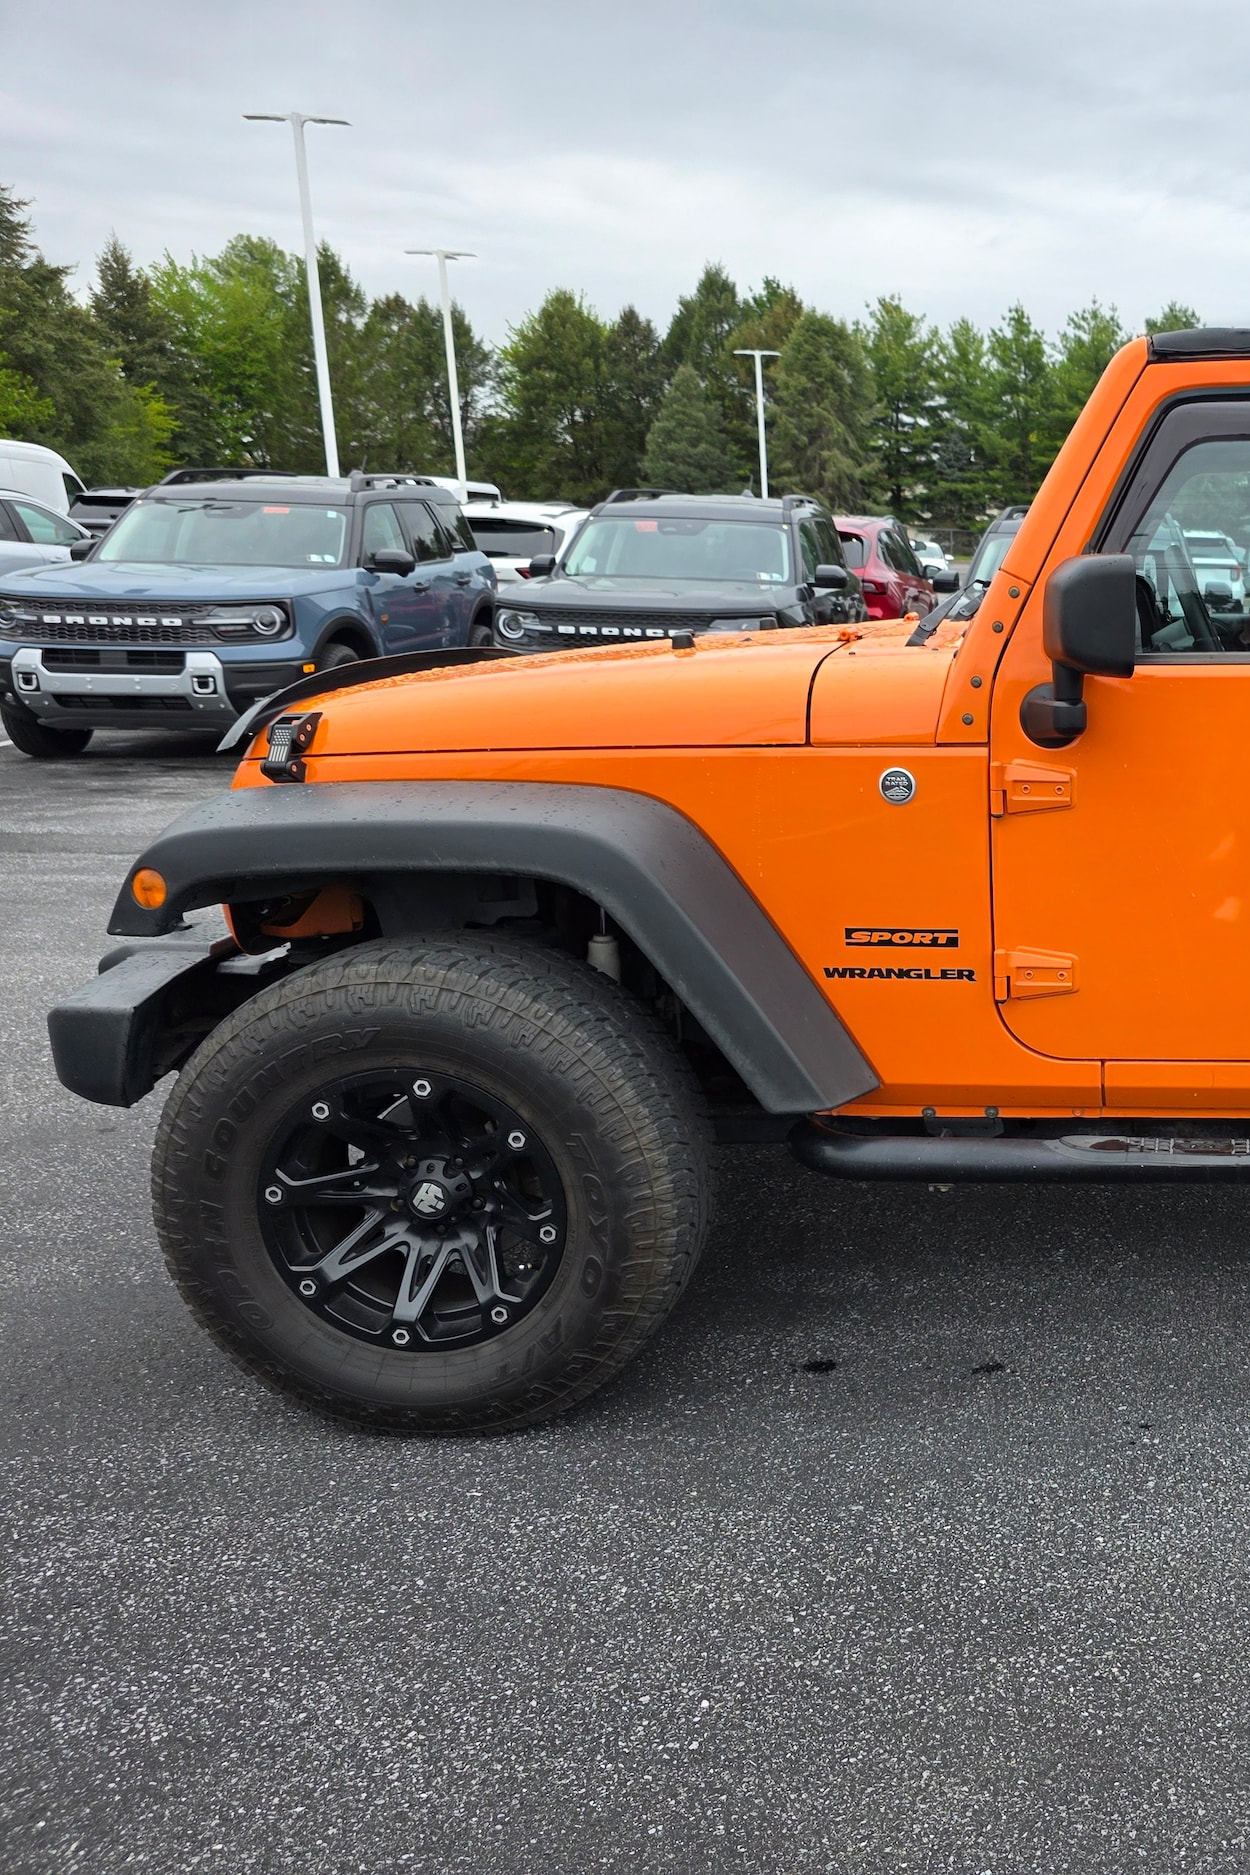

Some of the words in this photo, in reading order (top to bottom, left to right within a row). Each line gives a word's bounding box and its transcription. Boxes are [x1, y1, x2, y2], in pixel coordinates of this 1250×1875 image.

[43, 615, 182, 627] BRONCO
[845, 929, 958, 946] SPORT
[823, 967, 977, 982] WRANGLER
[202, 1026, 381, 1184] COUNTRY
[564, 1132, 609, 1299] TOYO
